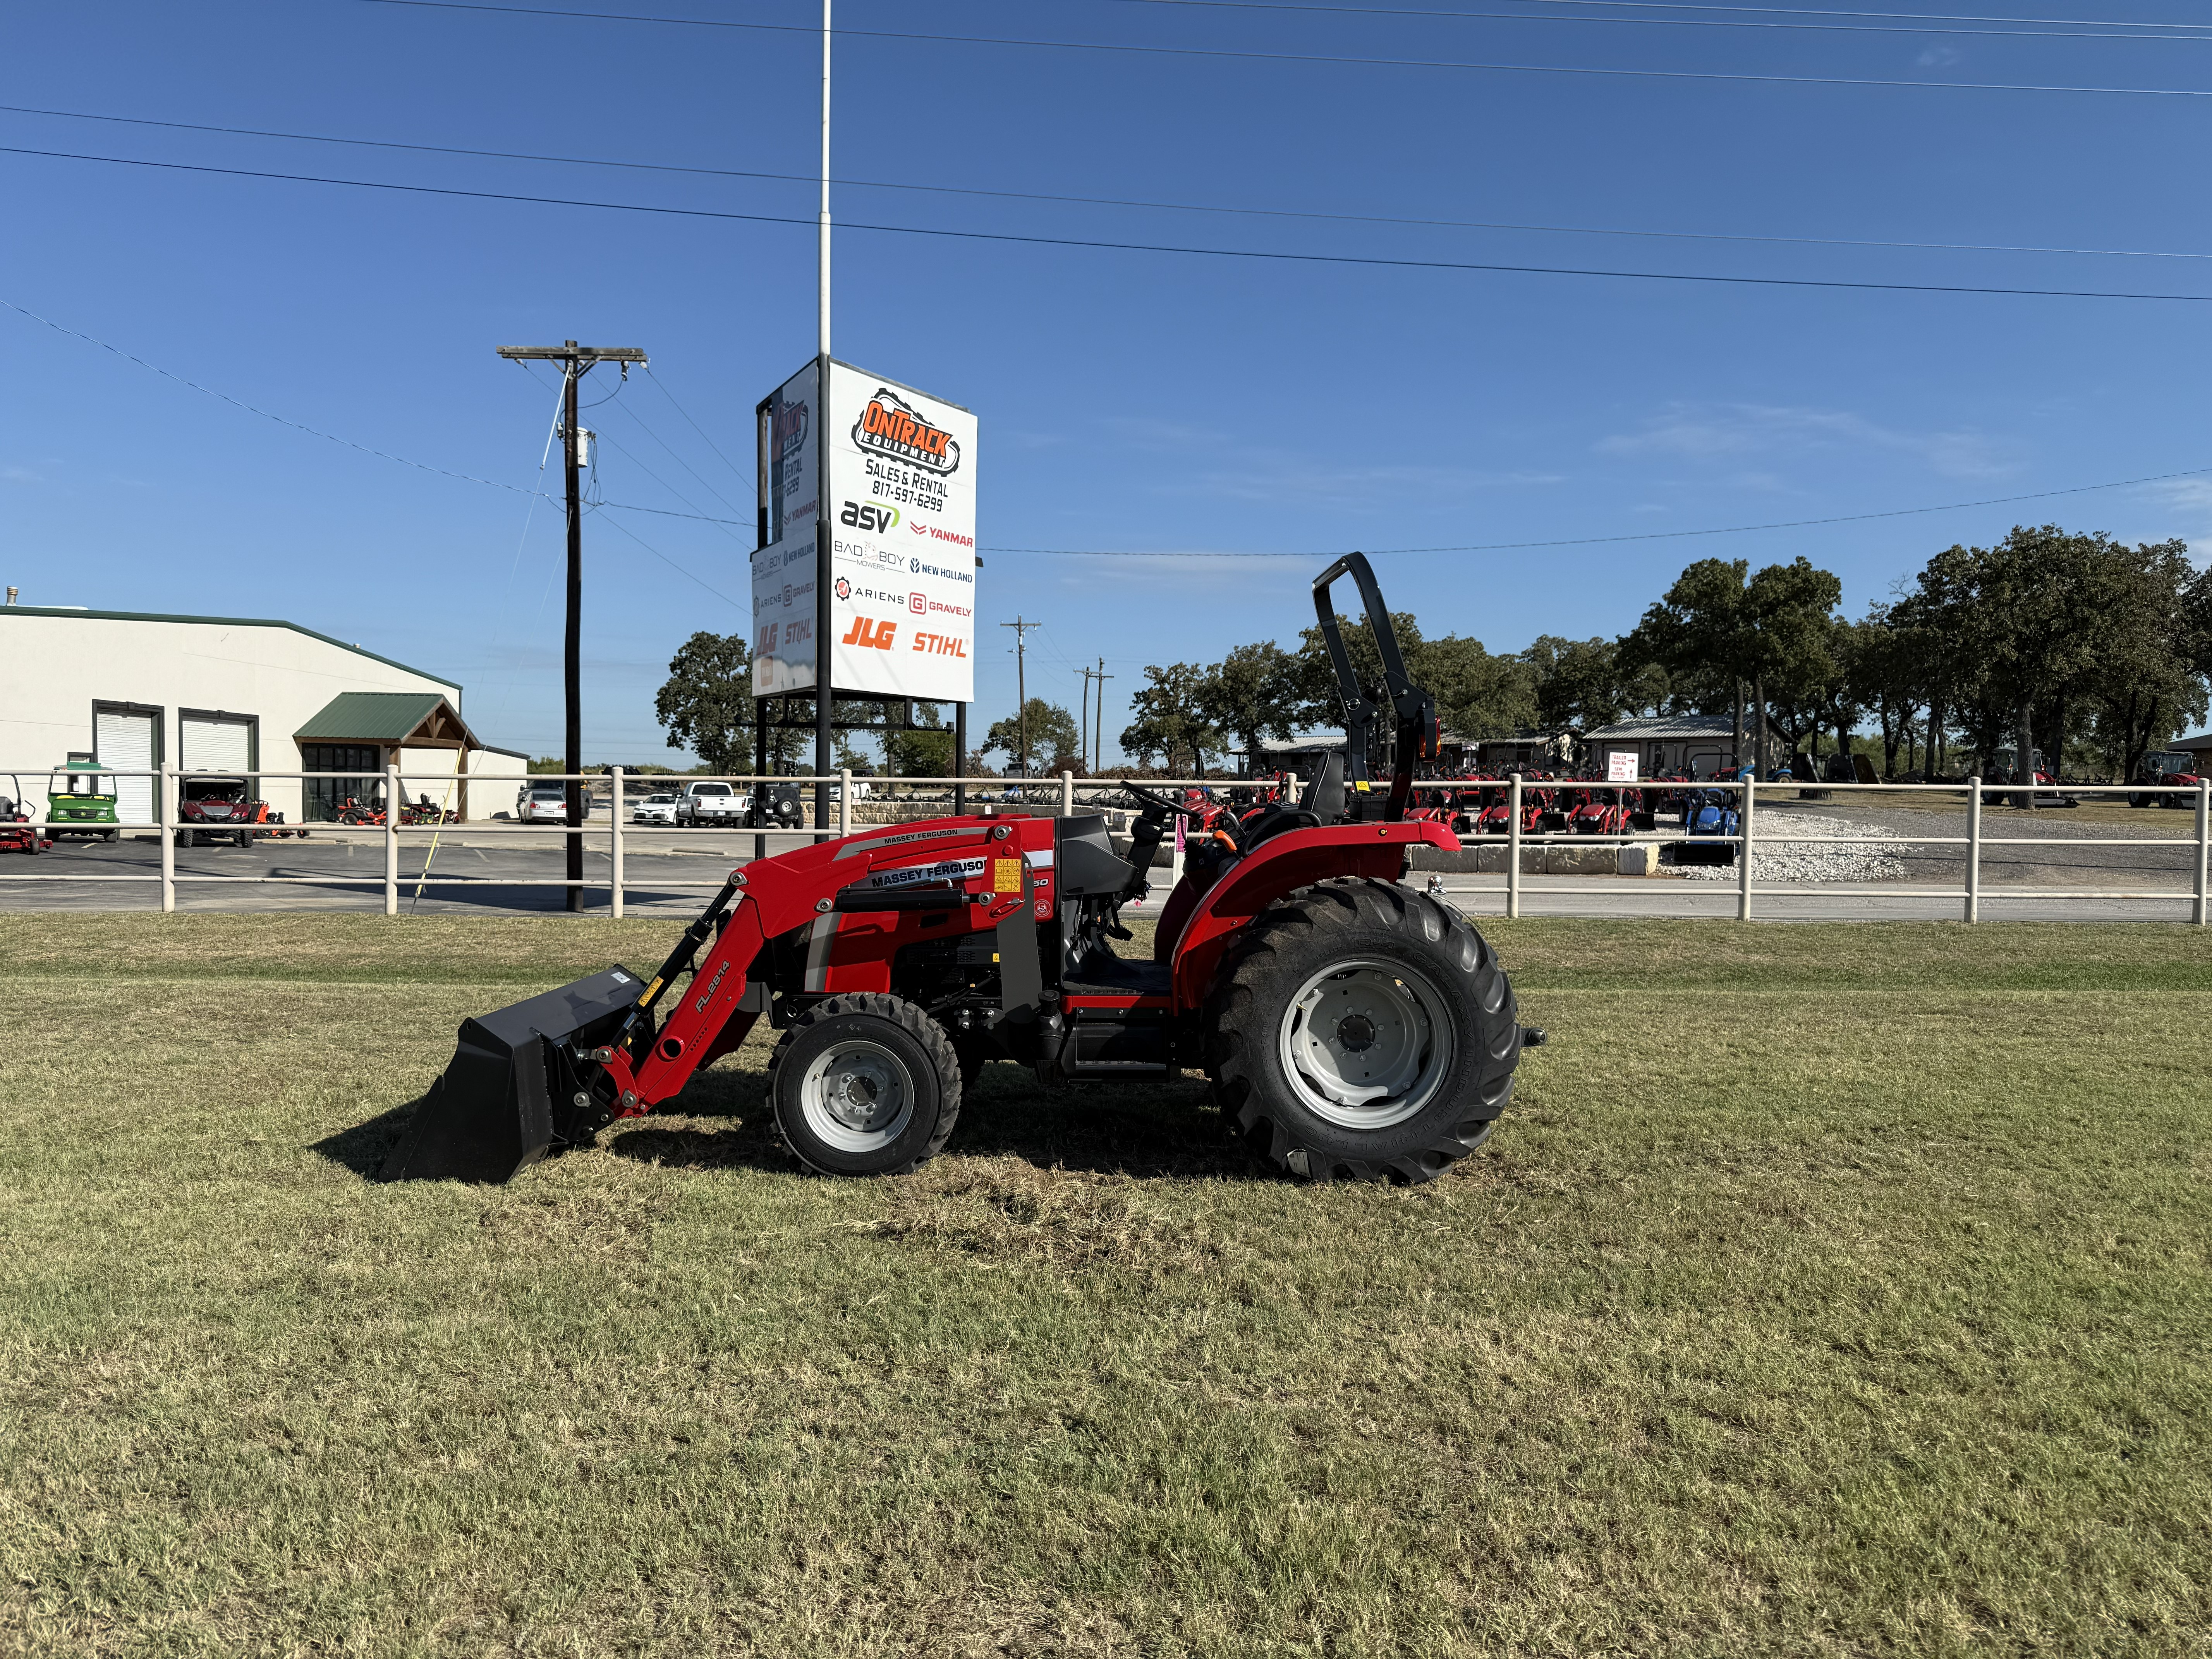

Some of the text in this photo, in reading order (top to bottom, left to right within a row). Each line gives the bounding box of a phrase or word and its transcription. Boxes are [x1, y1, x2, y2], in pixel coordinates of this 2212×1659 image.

[863, 433, 946, 466] EQUIPMENT
[785, 457, 802, 481] RENTAL
[866, 459, 948, 498] SALES & RENTAL
[872, 481, 943, 512] 817-597-6299
[792, 500, 816, 521] YANMAR
[930, 527, 973, 548] YANMAR
[769, 554, 781, 568] BOY
[788, 542, 815, 562] NEW HOLLAND
[835, 541, 905, 566] BAD BOY
[857, 559, 885, 571] MOWERS
[922, 564, 972, 583] NEW HOLLAND
[760, 594, 781, 609] ARIENS
[793, 581, 815, 598] GRAVELY
[855, 587, 904, 604] ARIENS
[929, 601, 972, 617] GRAVELY
[756, 622, 778, 656] JLG
[785, 618, 812, 645] STIHL
[842, 616, 897, 651] JLG
[912, 632, 967, 658] STIHL
[884, 829, 958, 844] MASSEY FERGUSON
[871, 860, 986, 887] MASSEY FERGUSO
[695, 960, 730, 1014] FL.2814
[1413, 951, 1474, 1040] GALAXY
